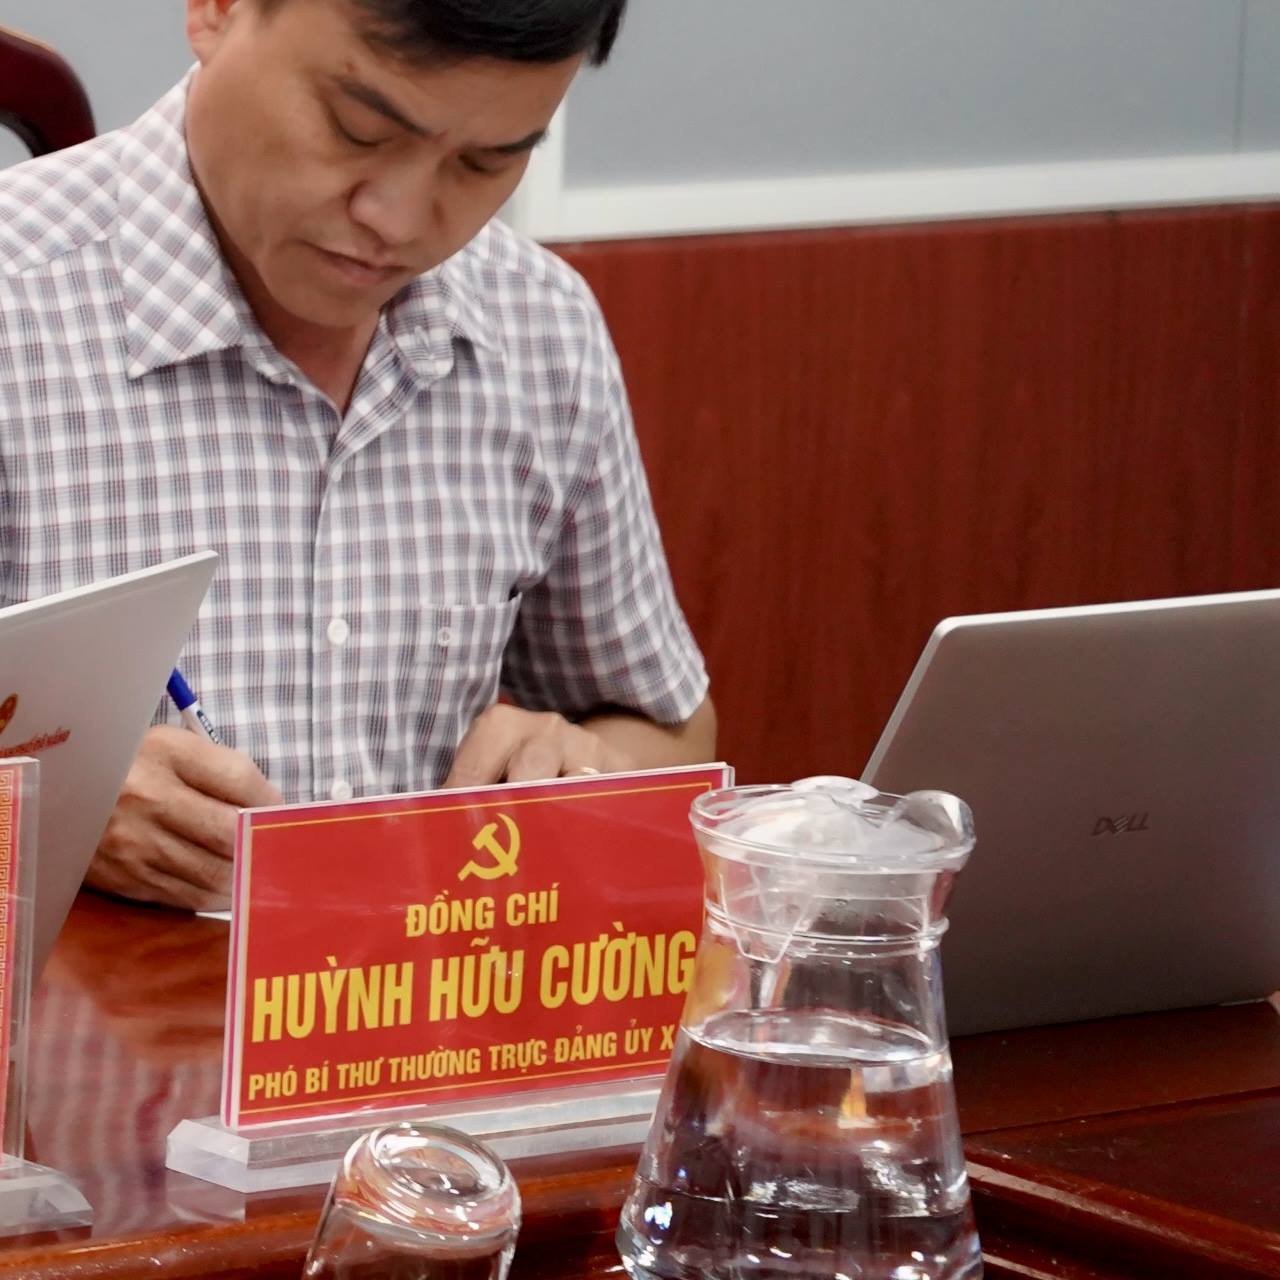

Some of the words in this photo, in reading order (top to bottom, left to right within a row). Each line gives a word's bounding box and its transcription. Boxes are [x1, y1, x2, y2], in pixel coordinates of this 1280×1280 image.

[1091, 812, 1151, 838] DELL
[404, 889, 496, 938] ĐỒNG
[506, 882, 560, 927] CHÍ
[250, 955, 413, 1044] HUỲNH
[428, 937, 525, 1024] HỮU
[540, 920, 697, 1010] CƯỜNG
[247, 1064, 298, 1102] PHÓ
[304, 1059, 329, 1095] BÍ
[336, 1055, 384, 1090] THƯ
[388, 1043, 482, 1084] THƯỜNG
[488, 1038, 549, 1074] TRỰC
[553, 1023, 618, 1064] ĐẢNG
[624, 1017, 655, 1055] ỦY
[659, 1023, 676, 1051] X
